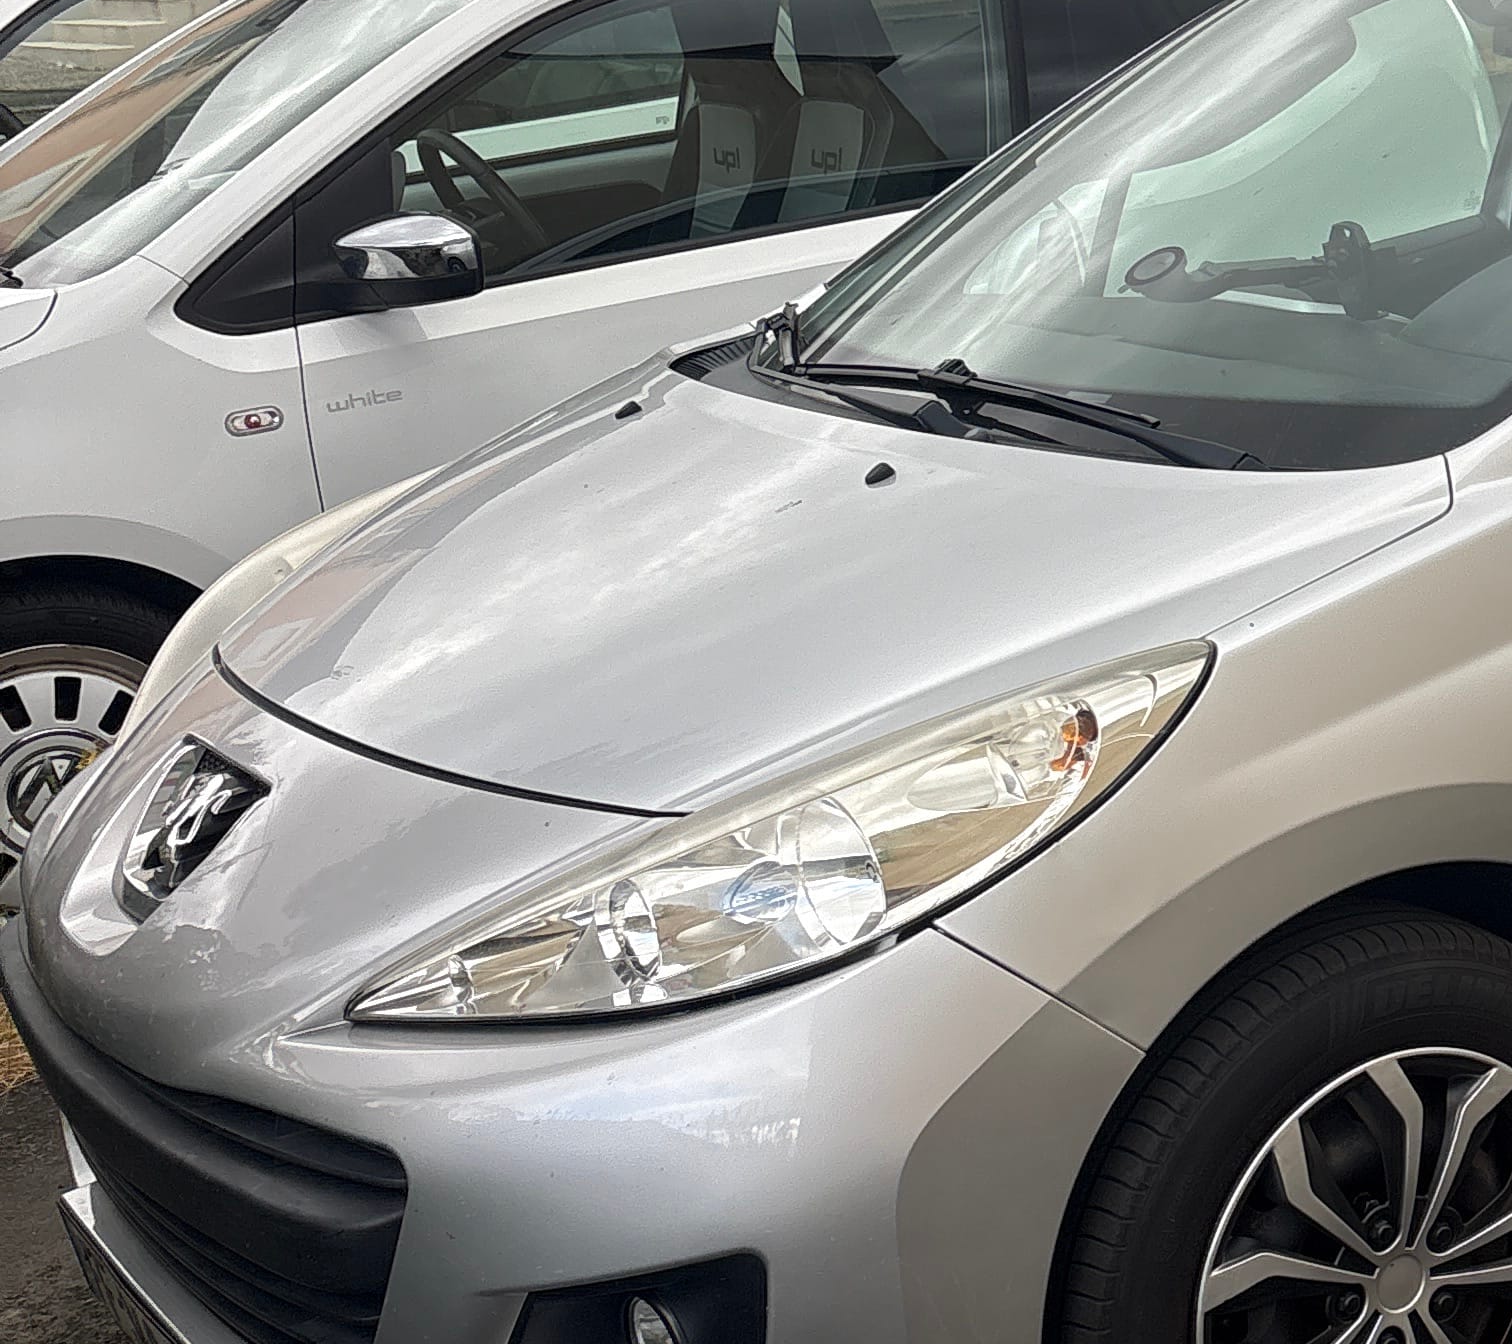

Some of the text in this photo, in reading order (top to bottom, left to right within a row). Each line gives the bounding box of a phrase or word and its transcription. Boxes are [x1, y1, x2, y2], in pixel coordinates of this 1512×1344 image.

[713, 146, 741, 174] up!
[810, 146, 842, 175] up!
[326, 389, 403, 413] white
